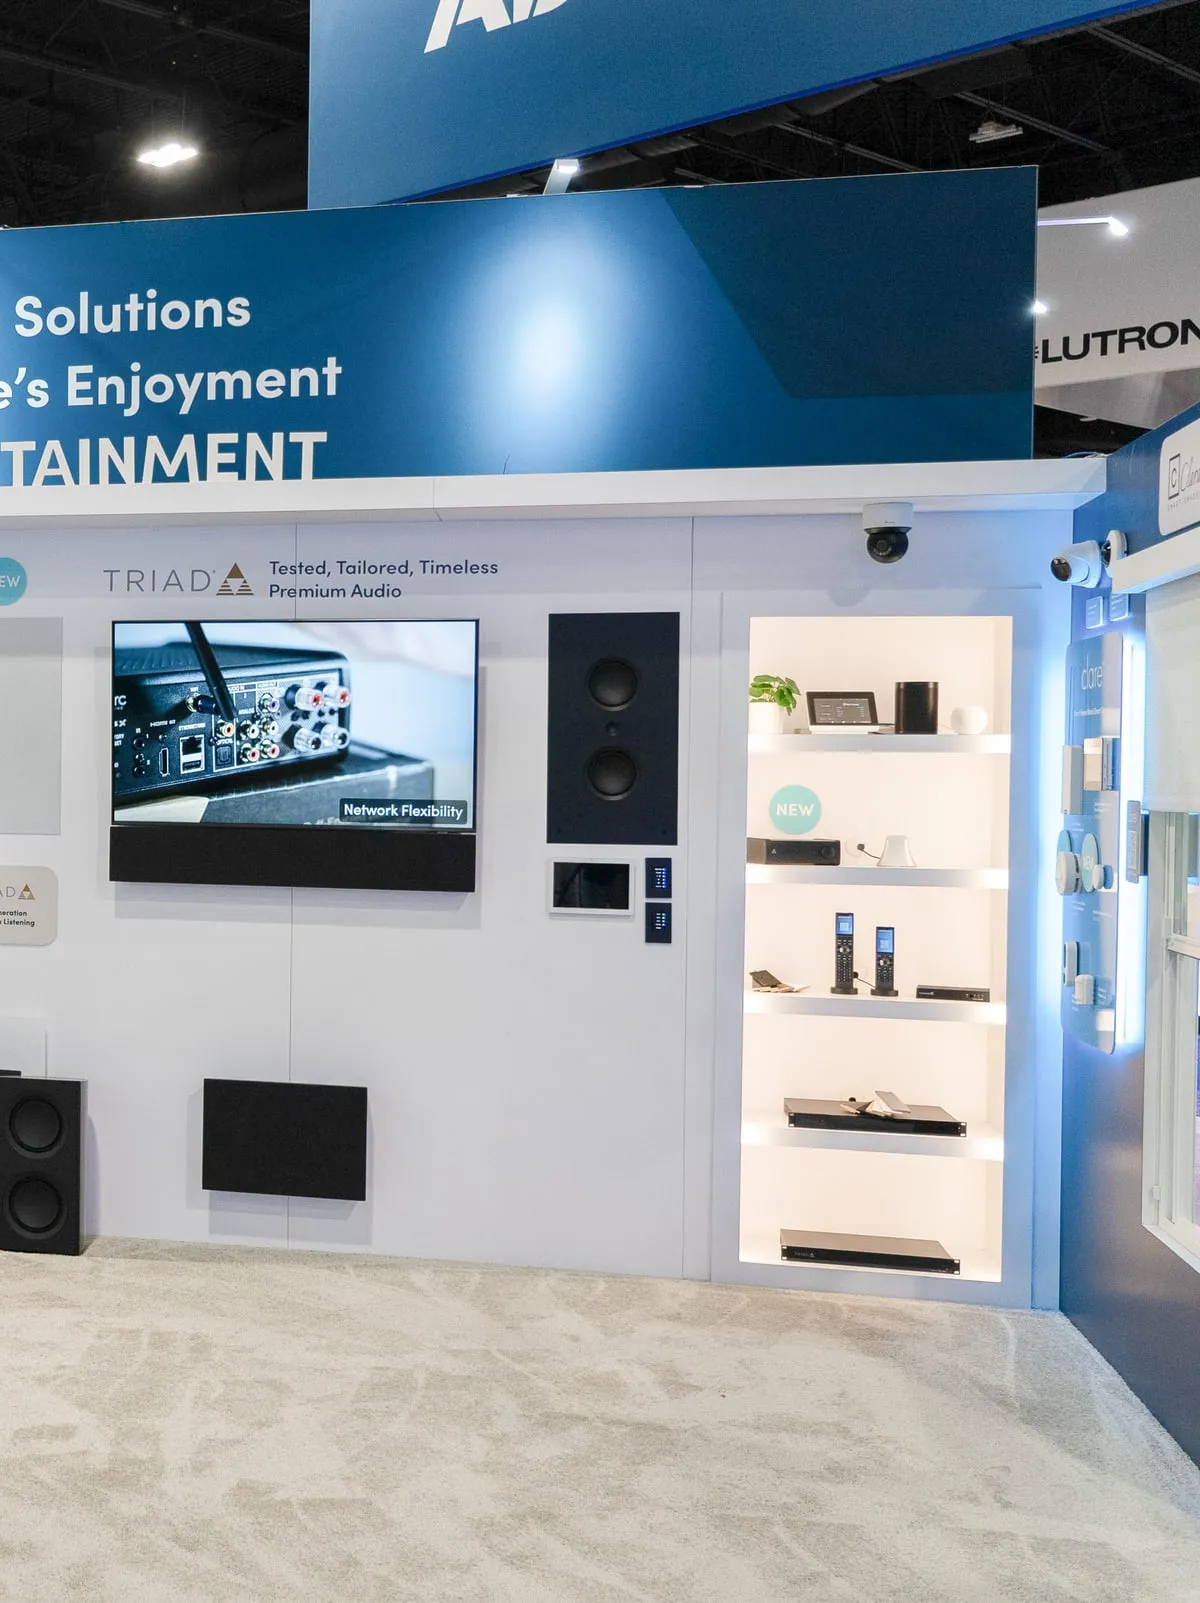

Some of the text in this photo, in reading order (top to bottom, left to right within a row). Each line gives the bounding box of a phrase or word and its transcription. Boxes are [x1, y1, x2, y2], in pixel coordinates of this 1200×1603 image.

[14, 288, 251, 338] Solutions
[1041, 318, 1200, 364] LUTRON
[67, 356, 342, 417] Enjoyment
[269, 560, 498, 577] Tested, Tailored, Timeless
[103, 569, 211, 592] TRIAD
[269, 584, 401, 598] Premium Audio
[344, 803, 463, 820] Network Flexibility
[776, 803, 815, 816] NEW
[3, 918, 35, 927] Listening
